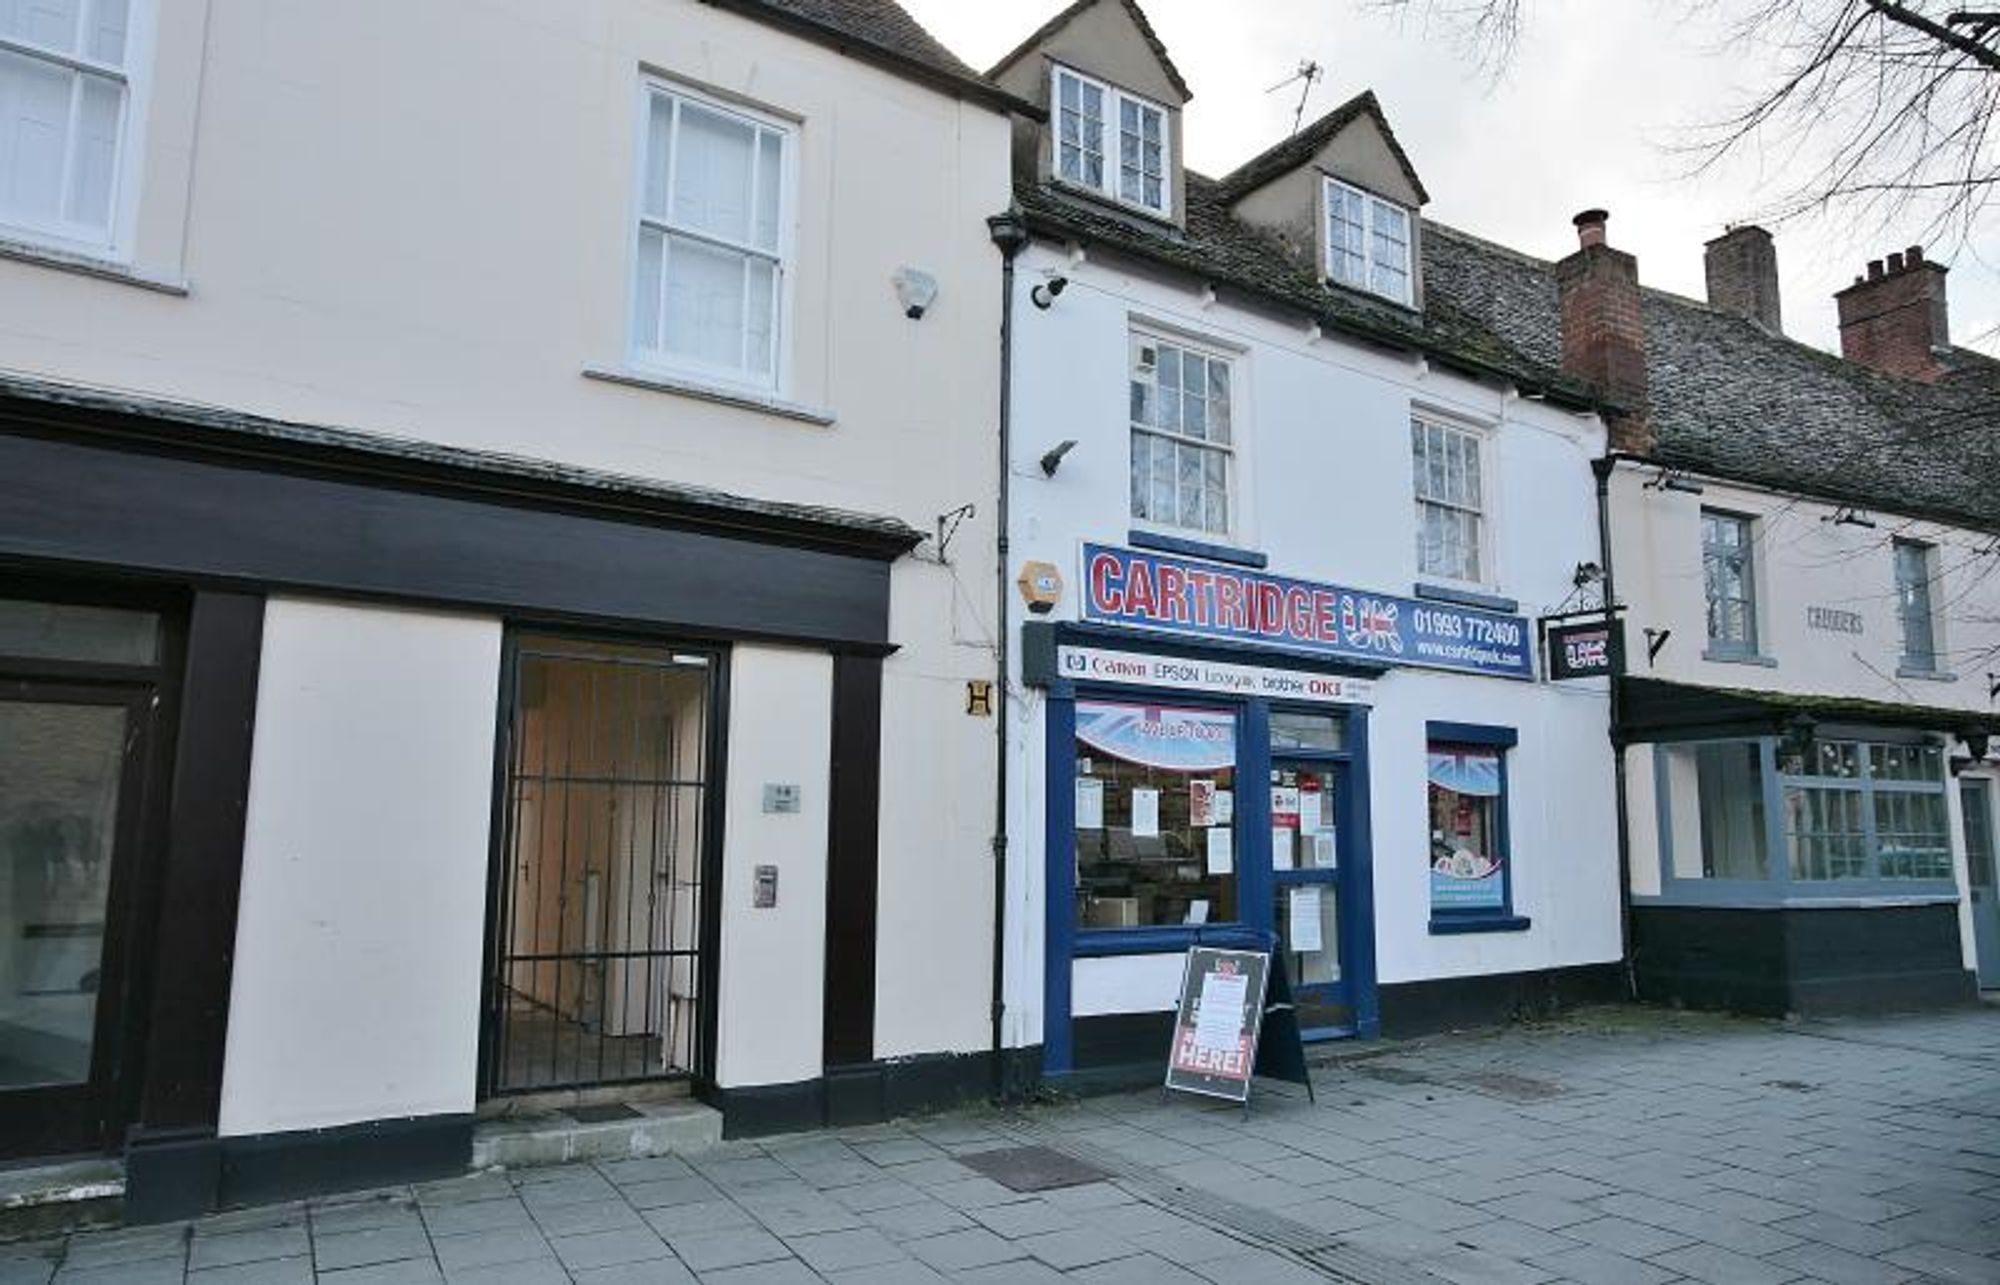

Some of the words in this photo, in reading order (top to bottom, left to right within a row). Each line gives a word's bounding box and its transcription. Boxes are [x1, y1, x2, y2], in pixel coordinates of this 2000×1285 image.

[1091, 553, 1338, 643] CARTRIDGE
[1341, 596, 1403, 651] UK
[1414, 609, 1462, 638] 01993
[1092, 658, 1146, 677] Canon
[1154, 665, 1198, 682] EPSON
